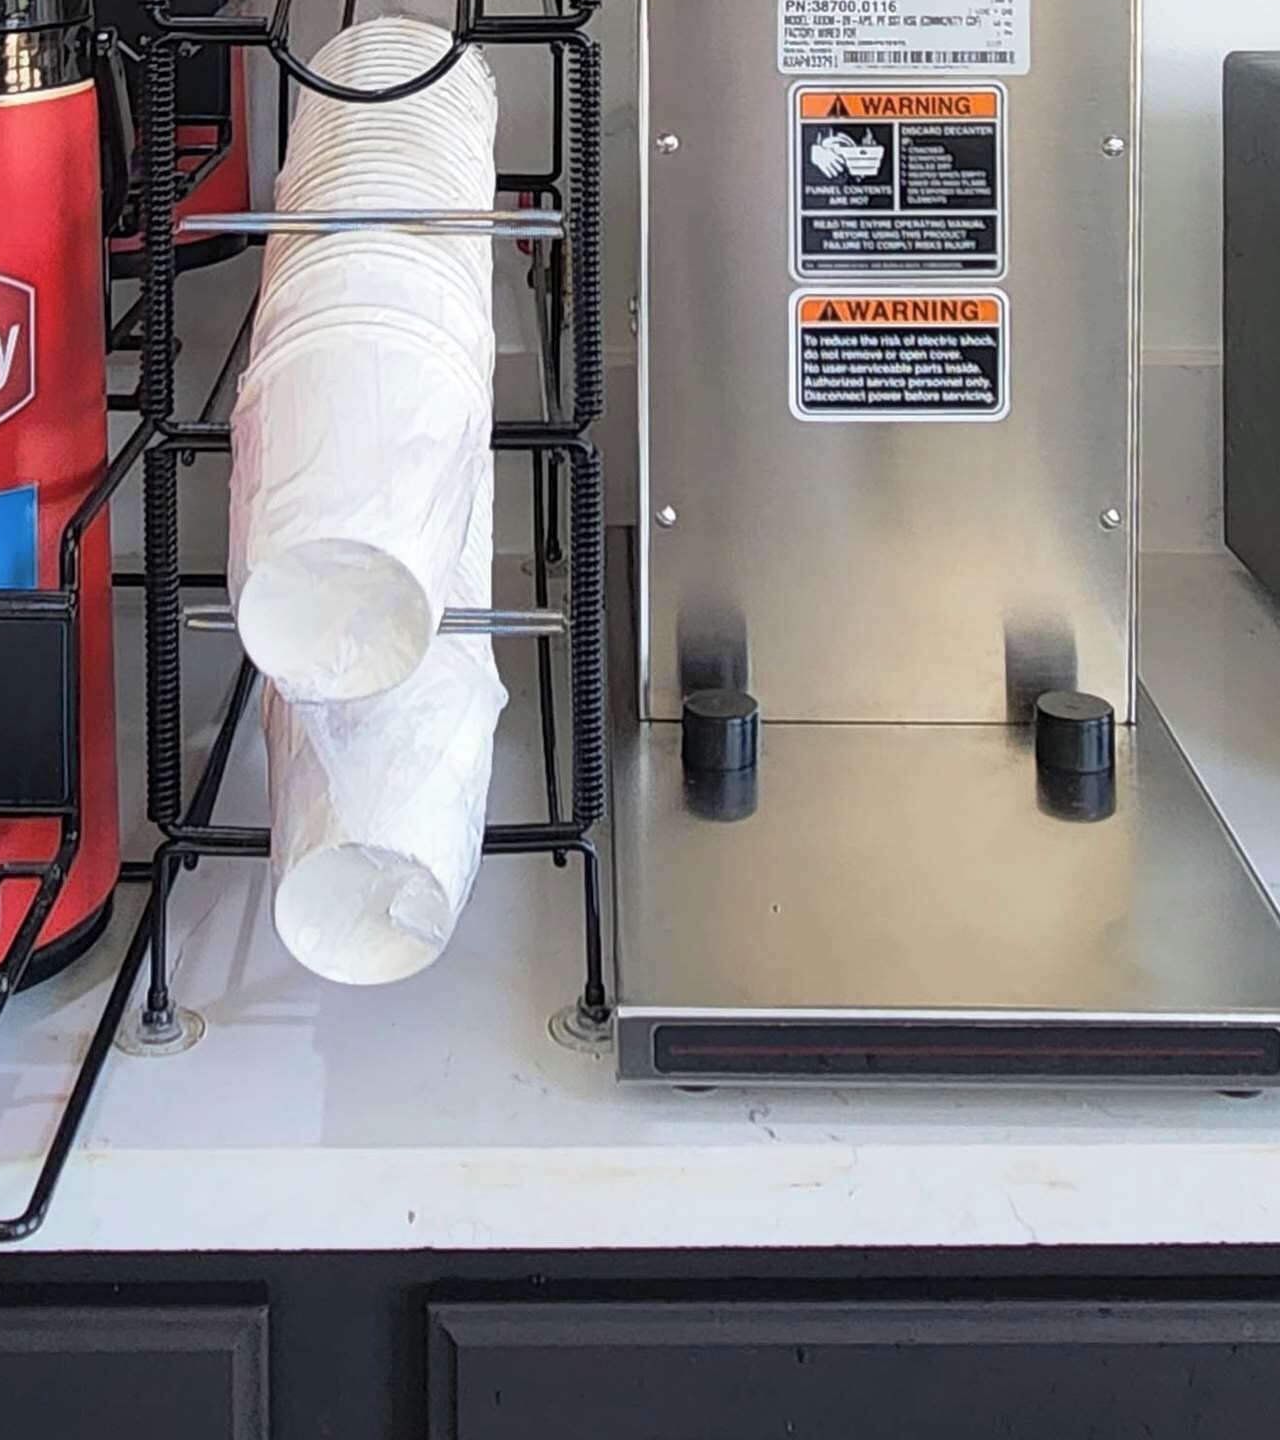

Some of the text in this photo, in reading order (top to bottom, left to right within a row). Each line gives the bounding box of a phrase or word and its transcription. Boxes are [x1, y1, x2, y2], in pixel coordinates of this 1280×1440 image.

[861, 97, 970, 116] WARNING
[847, 301, 979, 321] WARNING
[803, 334, 818, 346] To
[820, 334, 858, 346] reduce
[860, 334, 879, 346] the
[880, 334, 901, 346] risk
[903, 334, 915, 346] of
[917, 334, 959, 346] electric
[803, 349, 818, 360] do
[820, 349, 840, 360] not
[841, 349, 883, 360] remove
[885, 350, 897, 360] or
[898, 350, 927, 363] open
[804, 363, 819, 374] No
[915, 363, 943, 376] parts
[804, 376, 864, 387] Authorized
[866, 376, 906, 387] service
[908, 376, 963, 389] personnel
[804, 390, 866, 402] Disconnect
[867, 391, 902, 403] power
[903, 390, 940, 401] before
